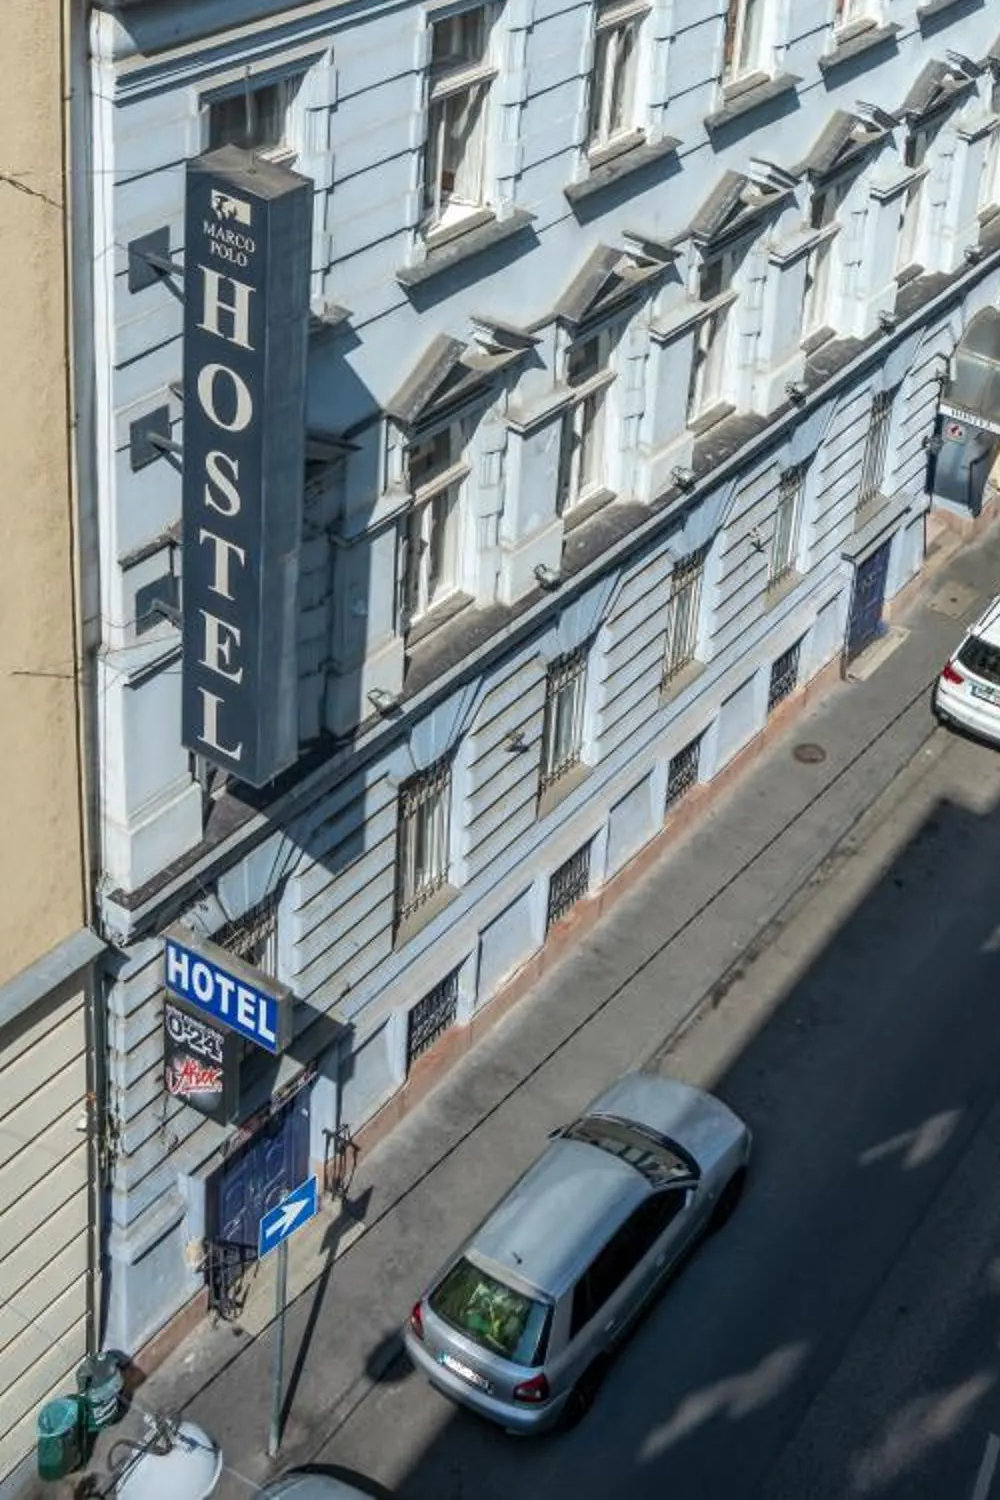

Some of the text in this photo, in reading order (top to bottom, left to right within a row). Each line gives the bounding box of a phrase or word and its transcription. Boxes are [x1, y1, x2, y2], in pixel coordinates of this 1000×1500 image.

[203, 220, 256, 253] MARCO
[210, 240, 248, 267] POLO
[196, 265, 256, 761] HOSTEL
[167, 945, 276, 1044] HOTEL
